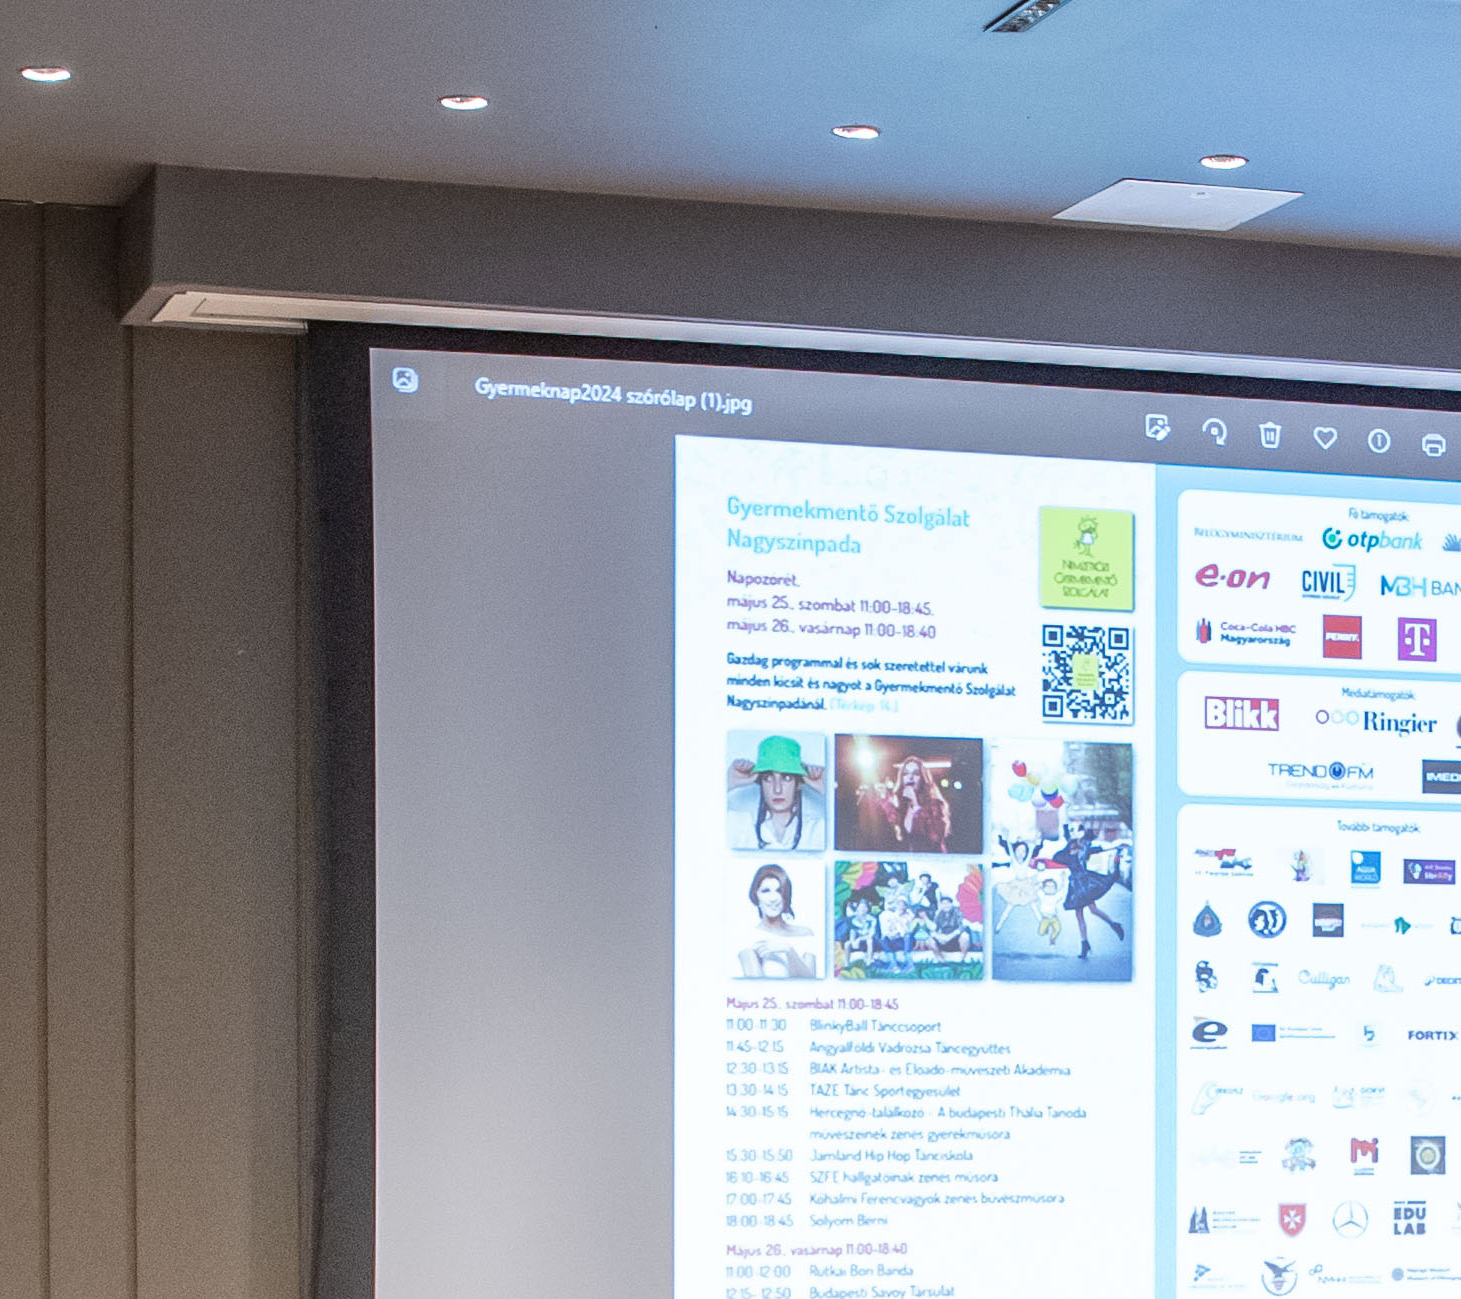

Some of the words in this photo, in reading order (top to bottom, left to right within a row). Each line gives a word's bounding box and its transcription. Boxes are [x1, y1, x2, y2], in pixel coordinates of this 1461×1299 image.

[474, 376, 623, 404] Gyermeknap2024
[626, 388, 696, 411] szórólap
[700, 391, 754, 416] (1).jpg
[727, 496, 879, 522] Gyermekmentő
[884, 504, 970, 531] Szolgálat
[727, 527, 862, 556] Nagyszínpada
[1302, 570, 1346, 594] CIVIL
[798, 597, 856, 613] szombat
[799, 622, 861, 640] vasárnap
[1221, 621, 1274, 633] Coca-Cola
[727, 652, 769, 670] Gazdag
[771, 655, 843, 672] programmal
[845, 656, 859, 670] és
[861, 657, 881, 671] sok
[883, 659, 946, 674] szeretettel
[947, 662, 988, 675] várunk
[727, 675, 771, 689] minden
[773, 674, 804, 690] kicsit
[807, 677, 821, 690] és
[822, 679, 862, 695] nagyot
[865, 683, 872, 692] a
[965, 682, 1016, 699] Szolgálat
[1205, 698, 1278, 730] Blikk
[1363, 710, 1438, 738] Ringier
[785, 996, 834, 1010] szombat
[1407, 1029, 1458, 1041] FORTIX
[865, 1150, 884, 1163] Hip
[887, 1150, 911, 1163] Hop
[1393, 1206, 1427, 1221] EDU
[1393, 1221, 1427, 1236] LAB
[877, 1263, 914, 1277] Banda
